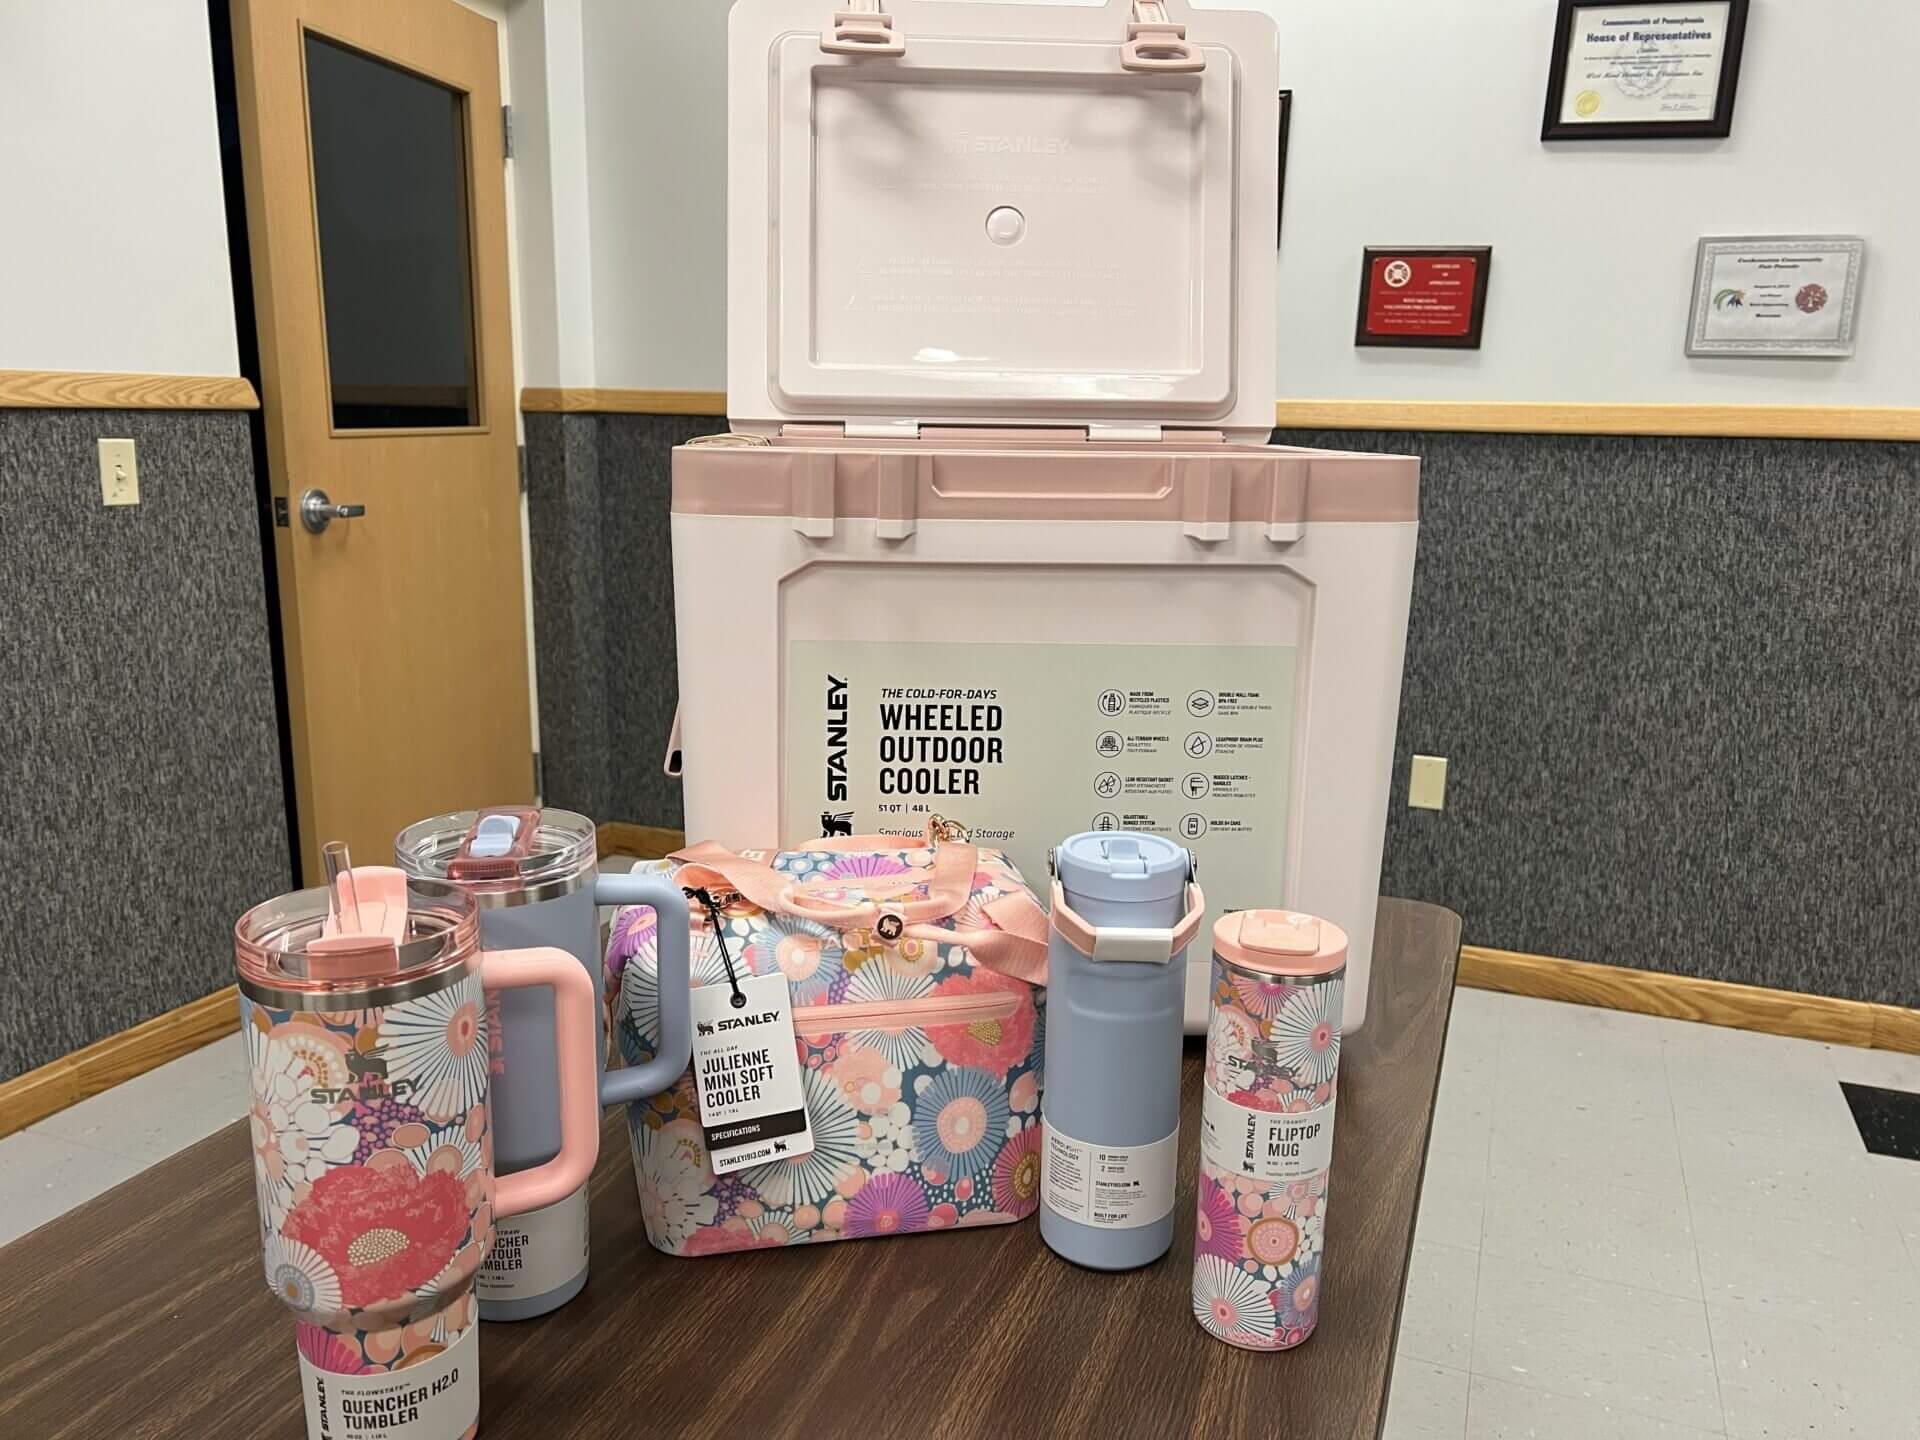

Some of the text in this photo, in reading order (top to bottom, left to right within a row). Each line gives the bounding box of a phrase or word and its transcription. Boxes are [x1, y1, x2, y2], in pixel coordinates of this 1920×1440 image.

[1662, 16, 1704, 25] Pennsylvania
[1586, 31, 1712, 43] House of Representatives
[974, 136, 1072, 155] STANLEY
[882, 688, 997, 700] THE COLD-FOR-DAYS
[880, 703, 1002, 731] WHEELED
[827, 674, 848, 801] STANLEY
[880, 735, 1003, 763] OUTDOOR
[880, 767, 979, 795] COOLER
[878, 804, 931, 813] 51 QT 48 L
[976, 829, 1015, 841] Storage
[718, 1011, 780, 1031] STANLEY
[702, 1049, 770, 1074] JULIENNE
[310, 1073, 423, 1104] STANLEY
[704, 1065, 774, 1092] MINI SOFT
[706, 1085, 761, 1108] COOLER
[711, 1124, 761, 1141] SPECIFICATIONS
[1246, 1113, 1256, 1159] STANLEY
[1269, 1123, 1320, 1141] FLIPTOP
[719, 1148, 771, 1167] STANLEY1913.COM
[1268, 1143, 1299, 1157] MUG
[342, 1368, 459, 1414] QUENCHER H2.0
[315, 1376, 329, 1432] STANLEY
[344, 1407, 418, 1430] TUMBLER
